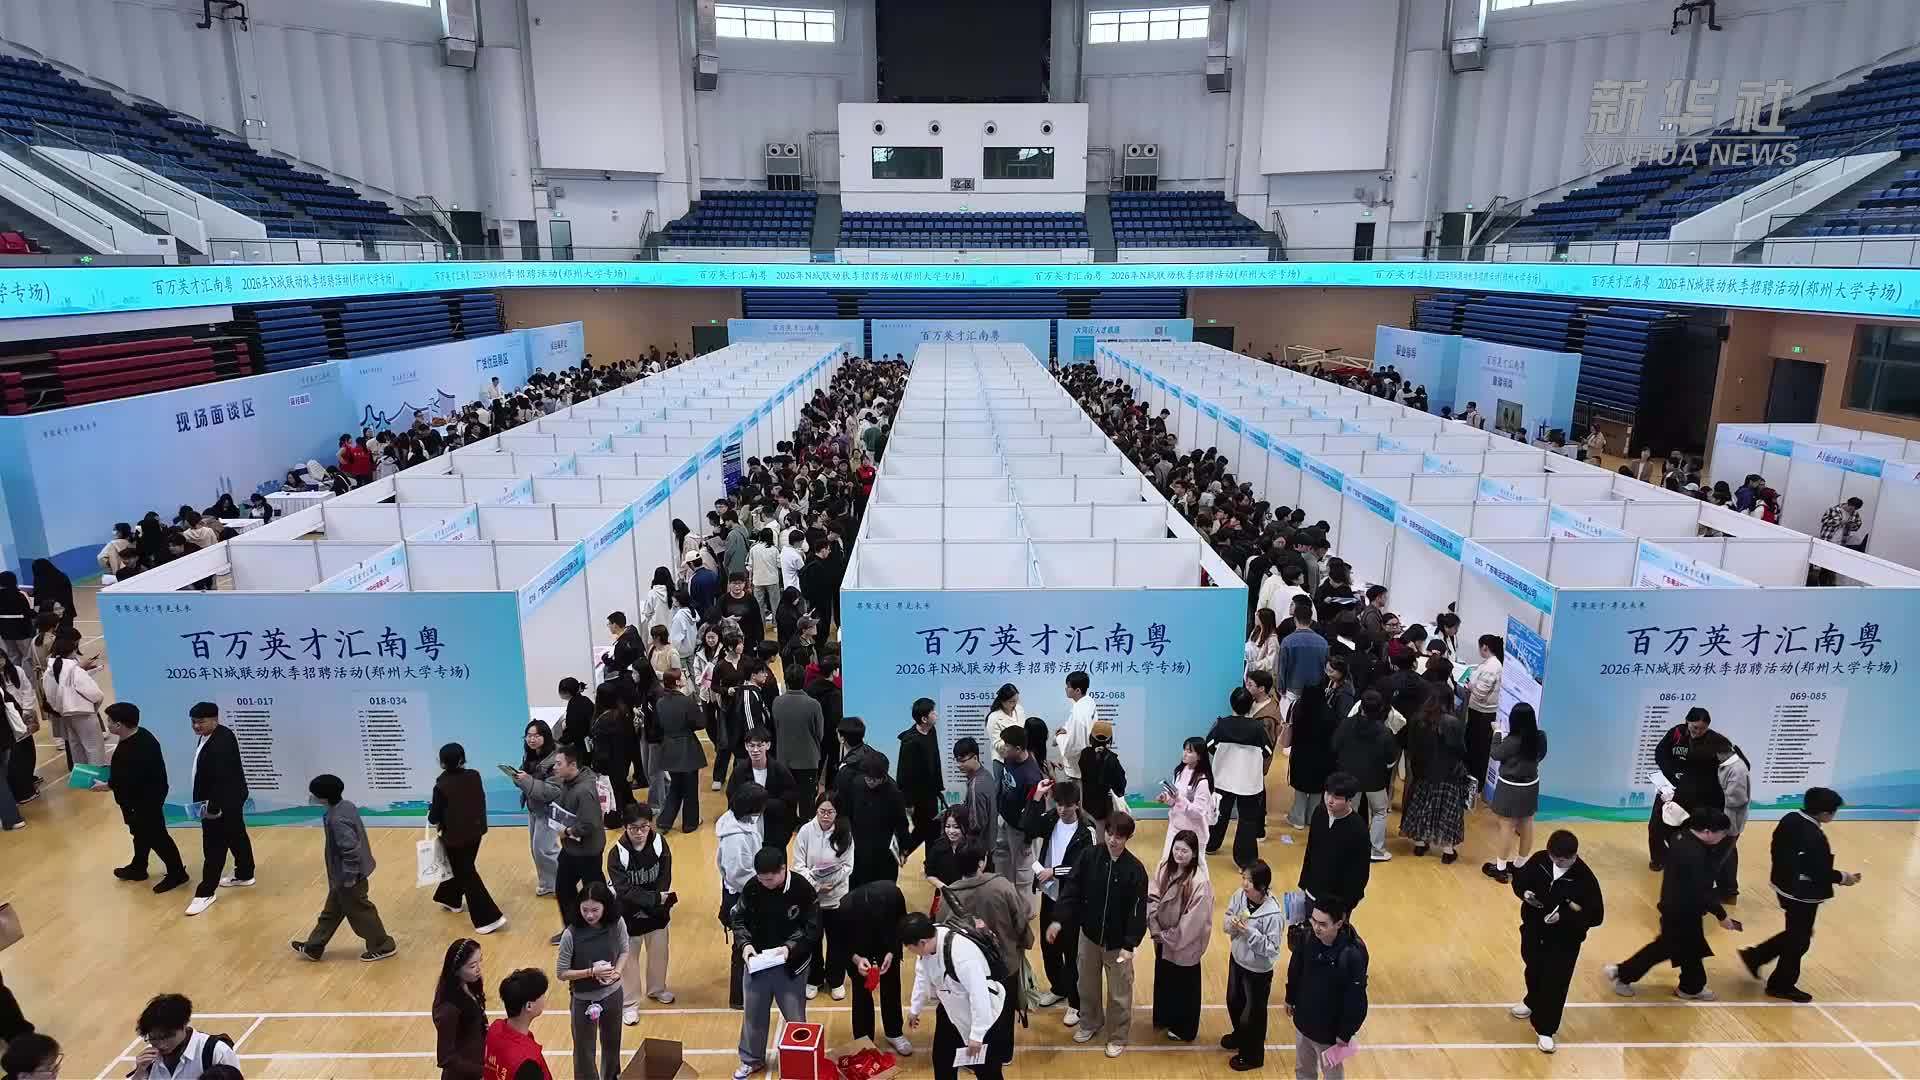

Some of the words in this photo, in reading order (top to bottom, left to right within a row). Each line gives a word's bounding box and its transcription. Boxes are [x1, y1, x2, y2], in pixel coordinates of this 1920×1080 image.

[699, 271, 768, 281] 百万英才汇南粤
[1032, 271, 1103, 281] 百万英才汇南粤
[152, 276, 233, 296] 百万英才汇南粤
[1591, 274, 1650, 290] 百万英才汇南粤
[1655, 276, 1904, 304] 2026年N城联动秋季招聘活动(郑州大学专场)
[919, 328, 1001, 342] 百万英才汇南粤
[175, 397, 257, 433] 现场面谈区
[180, 625, 446, 662] 百万英才汇南粤
[915, 622, 1172, 657] 百万英才汇南粤
[1626, 621, 1883, 658] 百万英才汇南粤
[166, 663, 470, 681] 2026年N城联动秋季招聘活动(郑州大学专场)
[895, 658, 1192, 677] 2026年N城联动秋季招聘活动(郑州大学专场)
[1599, 659, 1898, 677] 2026年N城联动秋季招聘活动(郑州大学专场)
[236, 697, 274, 706] 001-017
[369, 697, 408, 706] 018-034
[1089, 691, 1126, 699] 052-068
[1659, 692, 1697, 701] 086-102
[1790, 692, 1827, 701] 069-085
